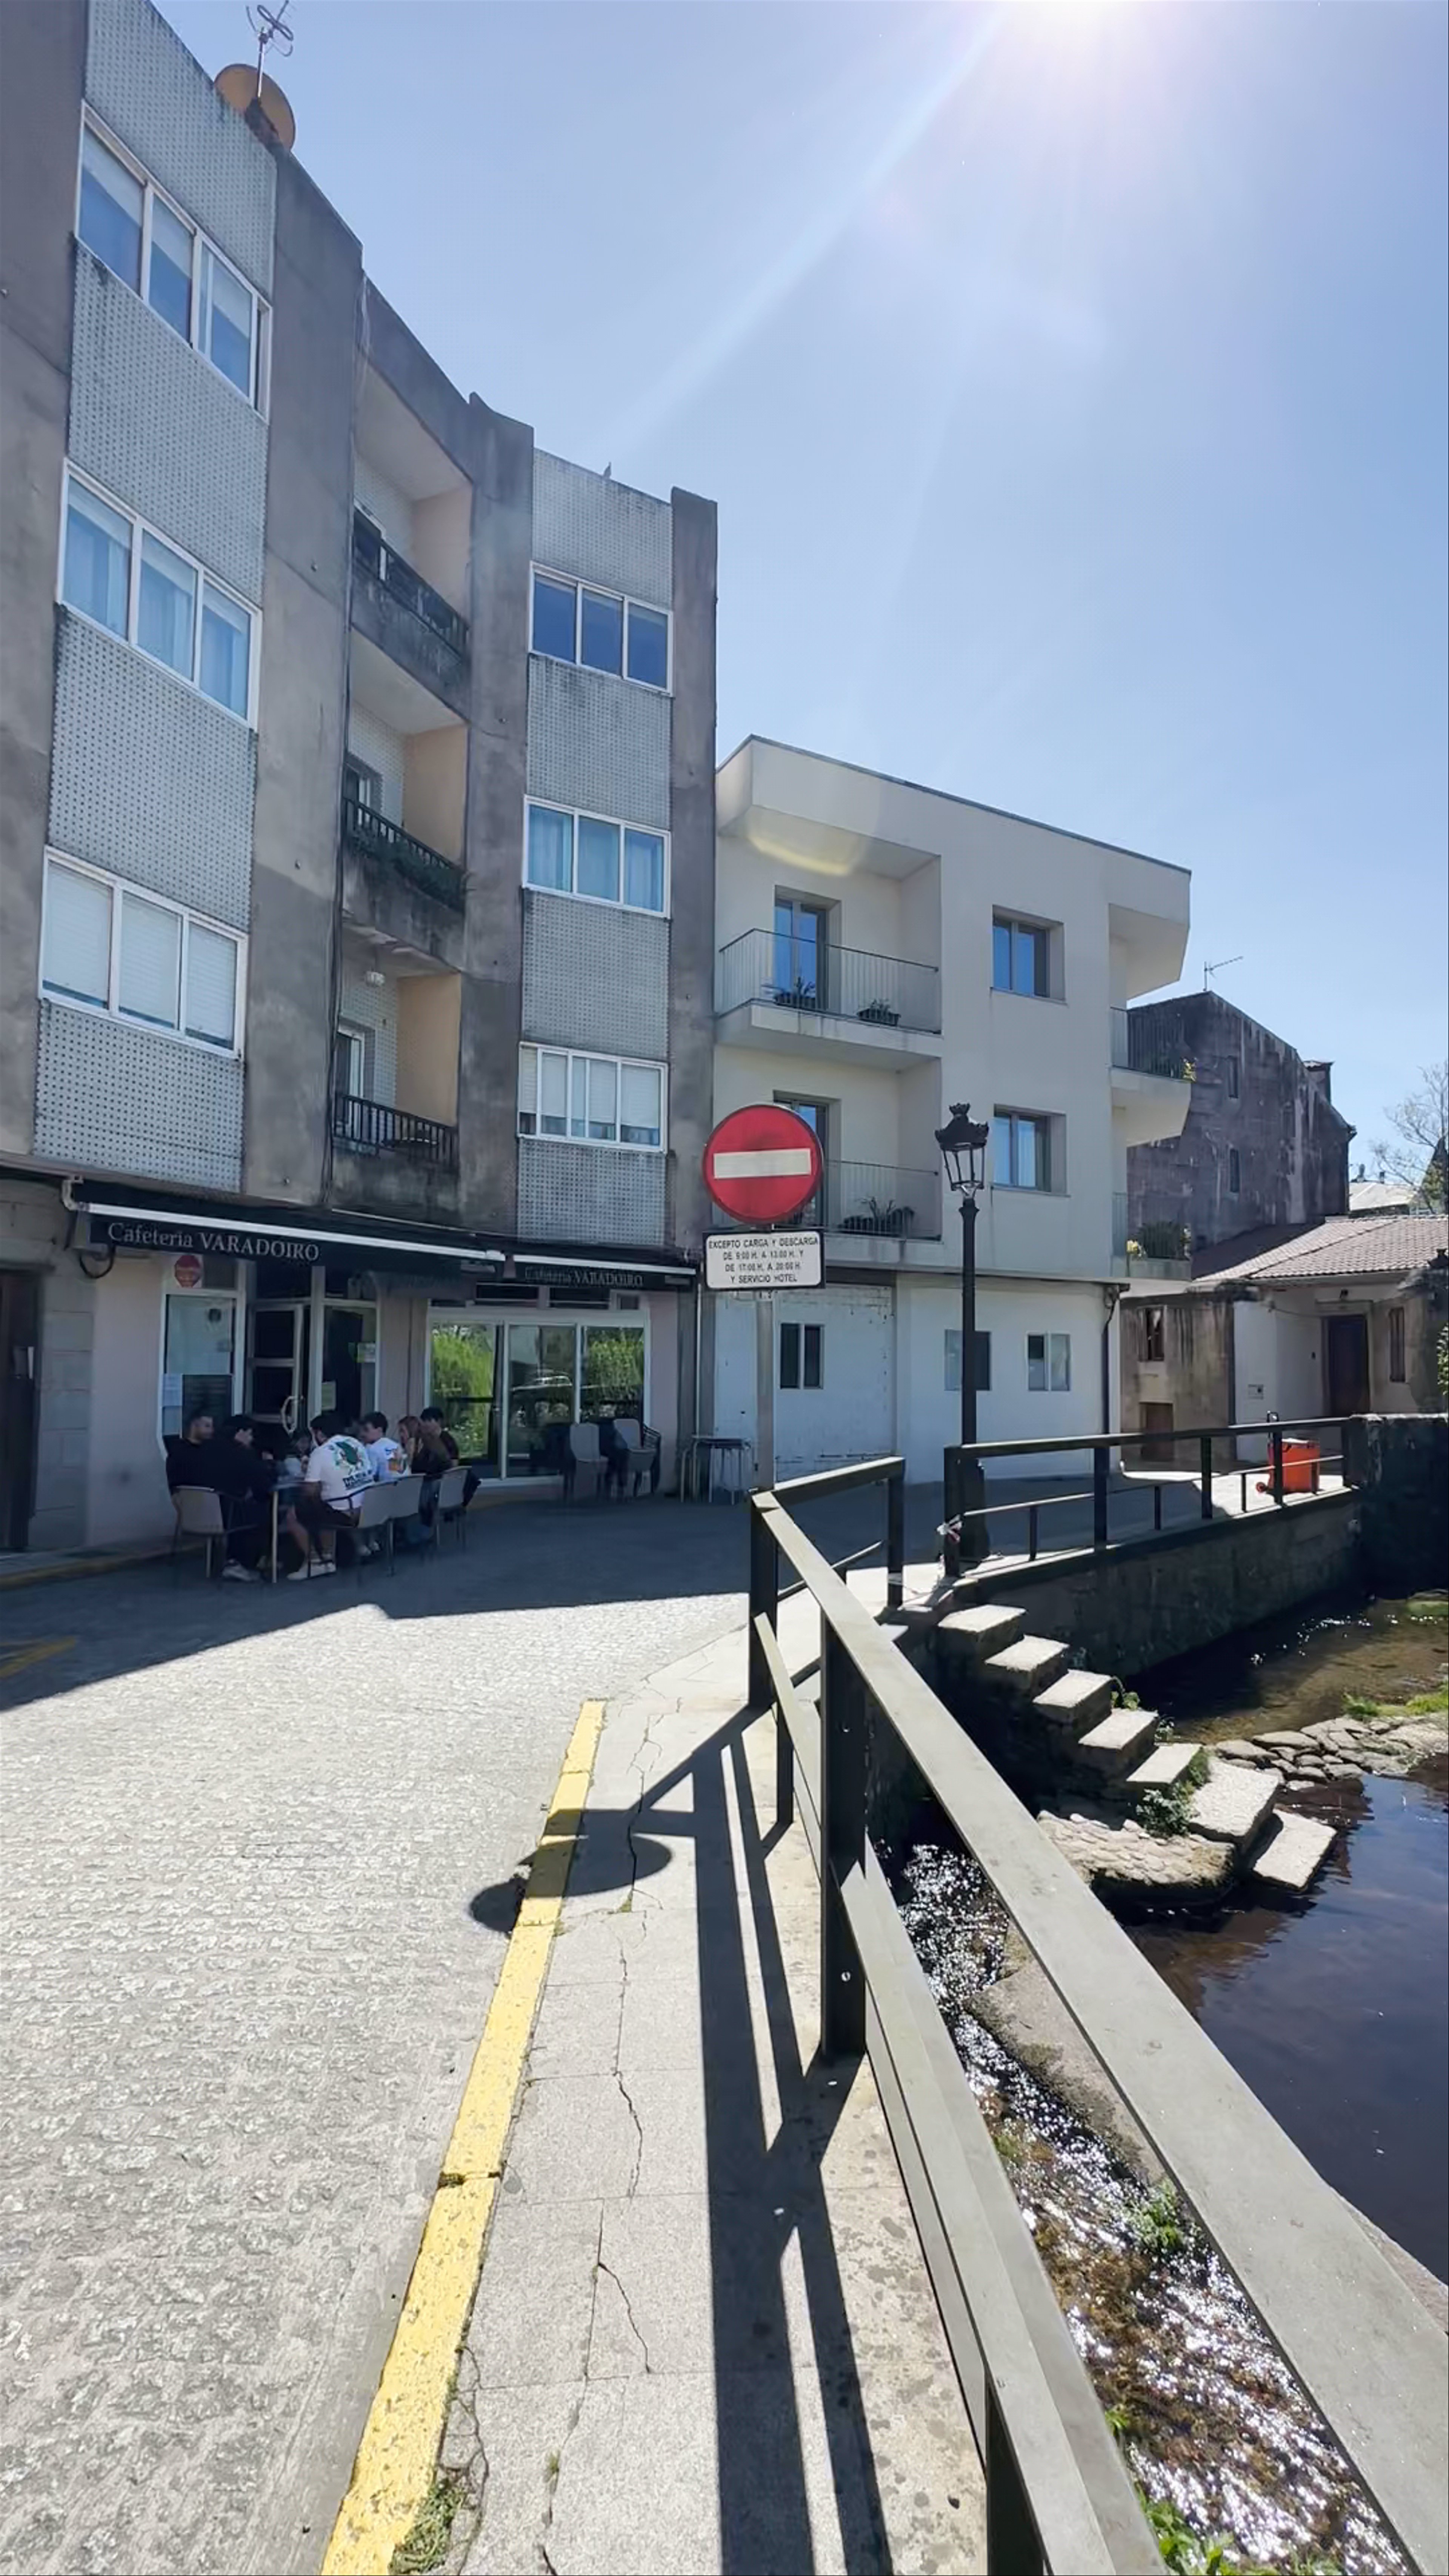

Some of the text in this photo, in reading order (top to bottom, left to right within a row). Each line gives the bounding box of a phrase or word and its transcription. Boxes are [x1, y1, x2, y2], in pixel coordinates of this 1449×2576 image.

[108, 1223, 319, 1261] Cafeteria VARADOIRO
[708, 1240, 740, 1249] EXCEPTO
[743, 1239, 769, 1248] CARGA
[779, 1237, 818, 1247] DESCARGA
[738, 1274, 770, 1284] SERVICIO
[774, 1273, 797, 1282] HOTEL
